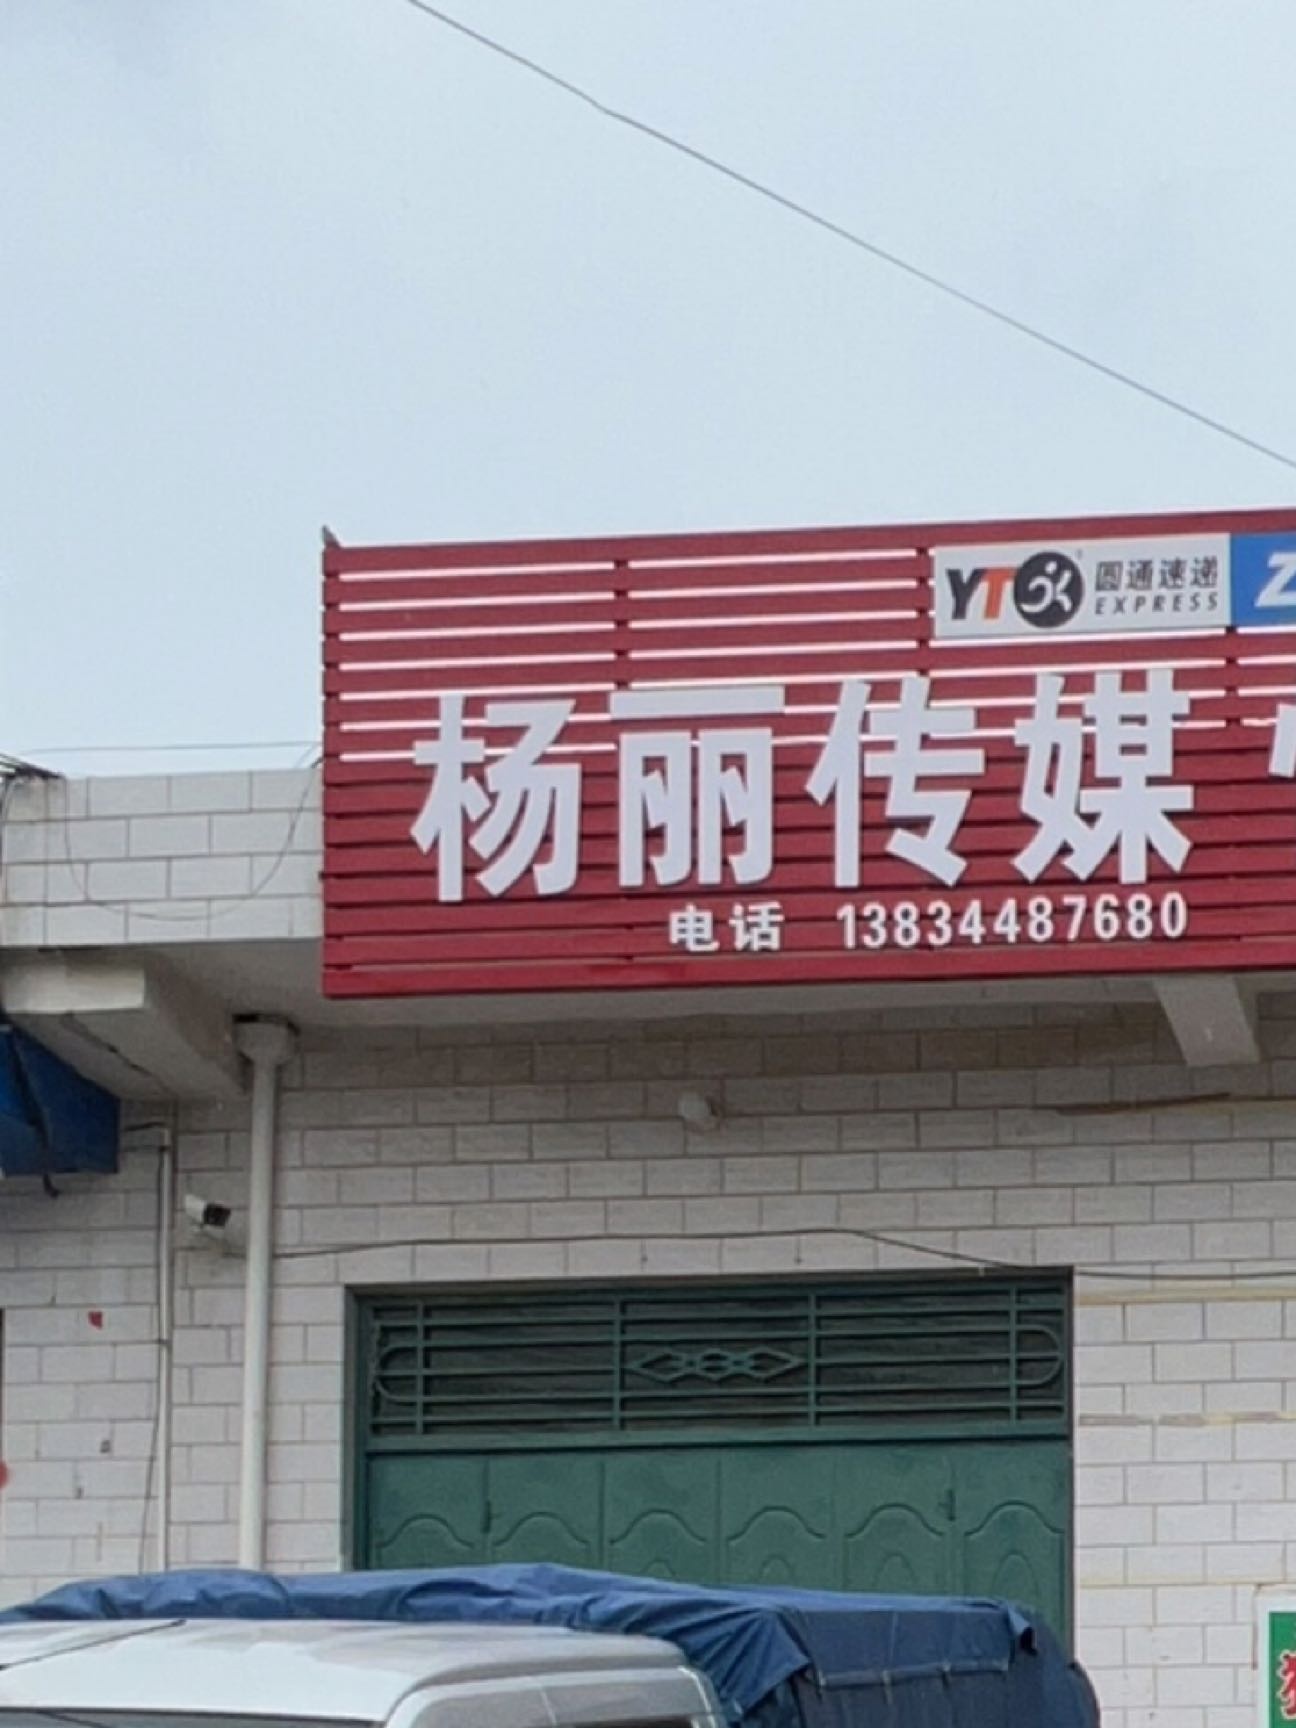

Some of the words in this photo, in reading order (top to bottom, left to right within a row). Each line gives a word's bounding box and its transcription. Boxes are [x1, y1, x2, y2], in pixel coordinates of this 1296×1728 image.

[1096, 556, 1218, 591] 圆通速递
[1095, 593, 1218, 615] EXPRESS
[668, 902, 785, 953] 电话
[836, 890, 1189, 949] 13834487680
